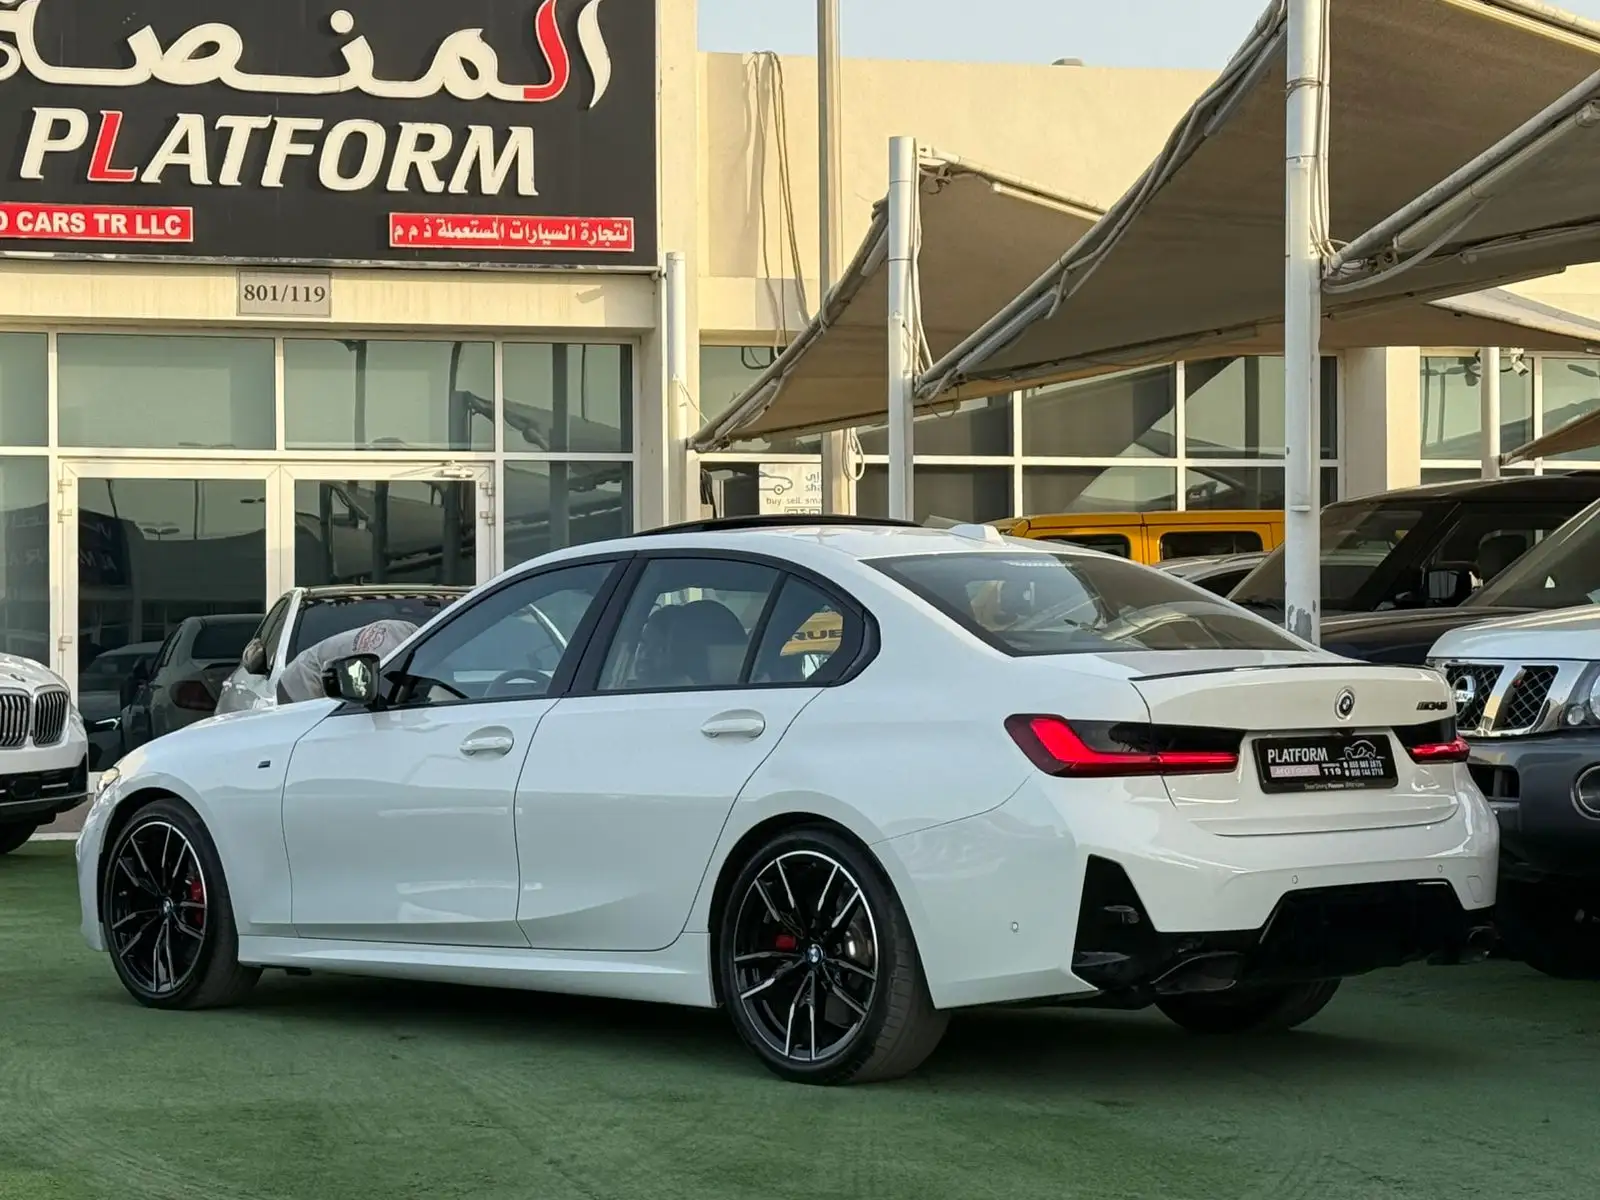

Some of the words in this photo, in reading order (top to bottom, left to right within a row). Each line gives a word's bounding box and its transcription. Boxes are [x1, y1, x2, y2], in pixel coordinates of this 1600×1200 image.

[20, 106, 539, 195] PLATFORM
[16, 211, 86, 233] CARS
[93, 213, 128, 234] TR
[135, 214, 182, 235] LLC
[394, 224, 404, 242] م
[408, 223, 419, 242] م
[436, 216, 505, 241] المستعملة
[509, 219, 575, 245] السيارات
[580, 220, 628, 246] لتجارة
[244, 284, 326, 303] 801/119
[1267, 747, 1329, 763] PLATFORM
